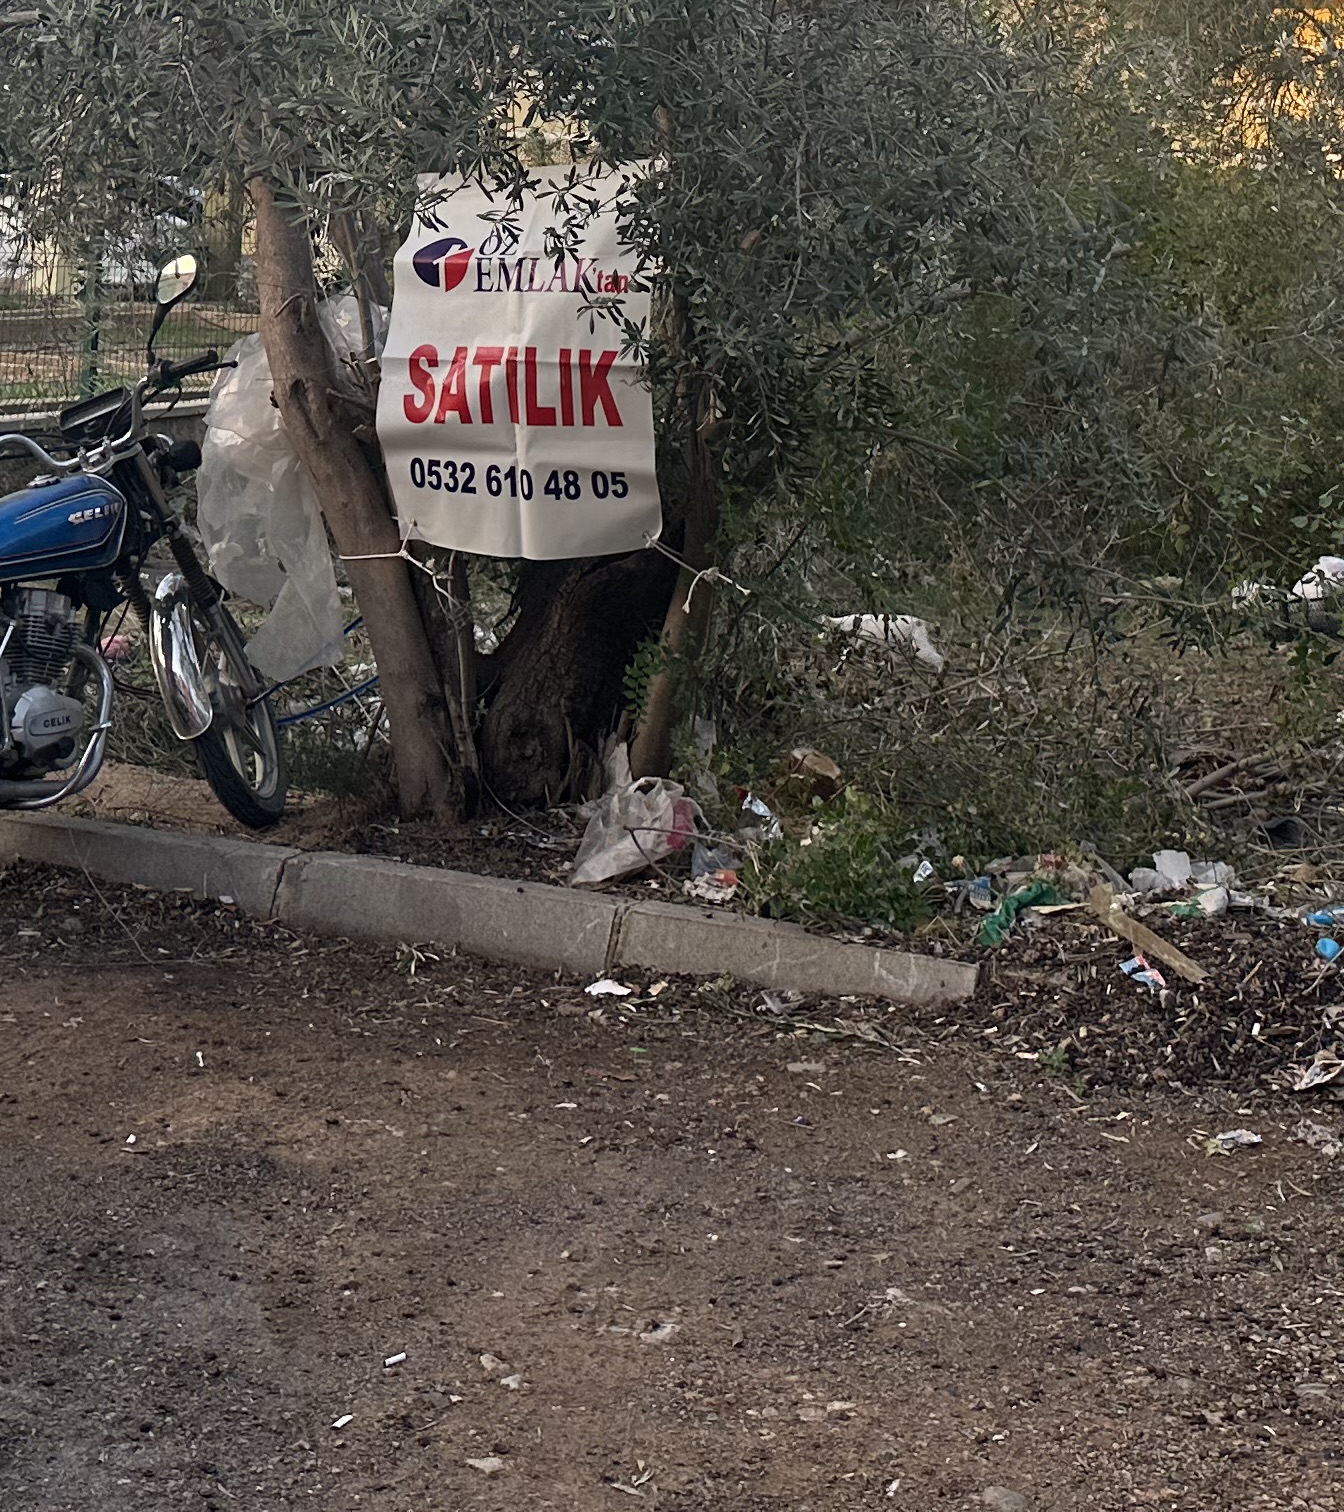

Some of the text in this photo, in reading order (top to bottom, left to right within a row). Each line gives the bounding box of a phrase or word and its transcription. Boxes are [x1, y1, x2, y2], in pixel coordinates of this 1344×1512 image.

[403, 343, 624, 427] SATILIK
[410, 457, 629, 501] 0532 610 48 05
